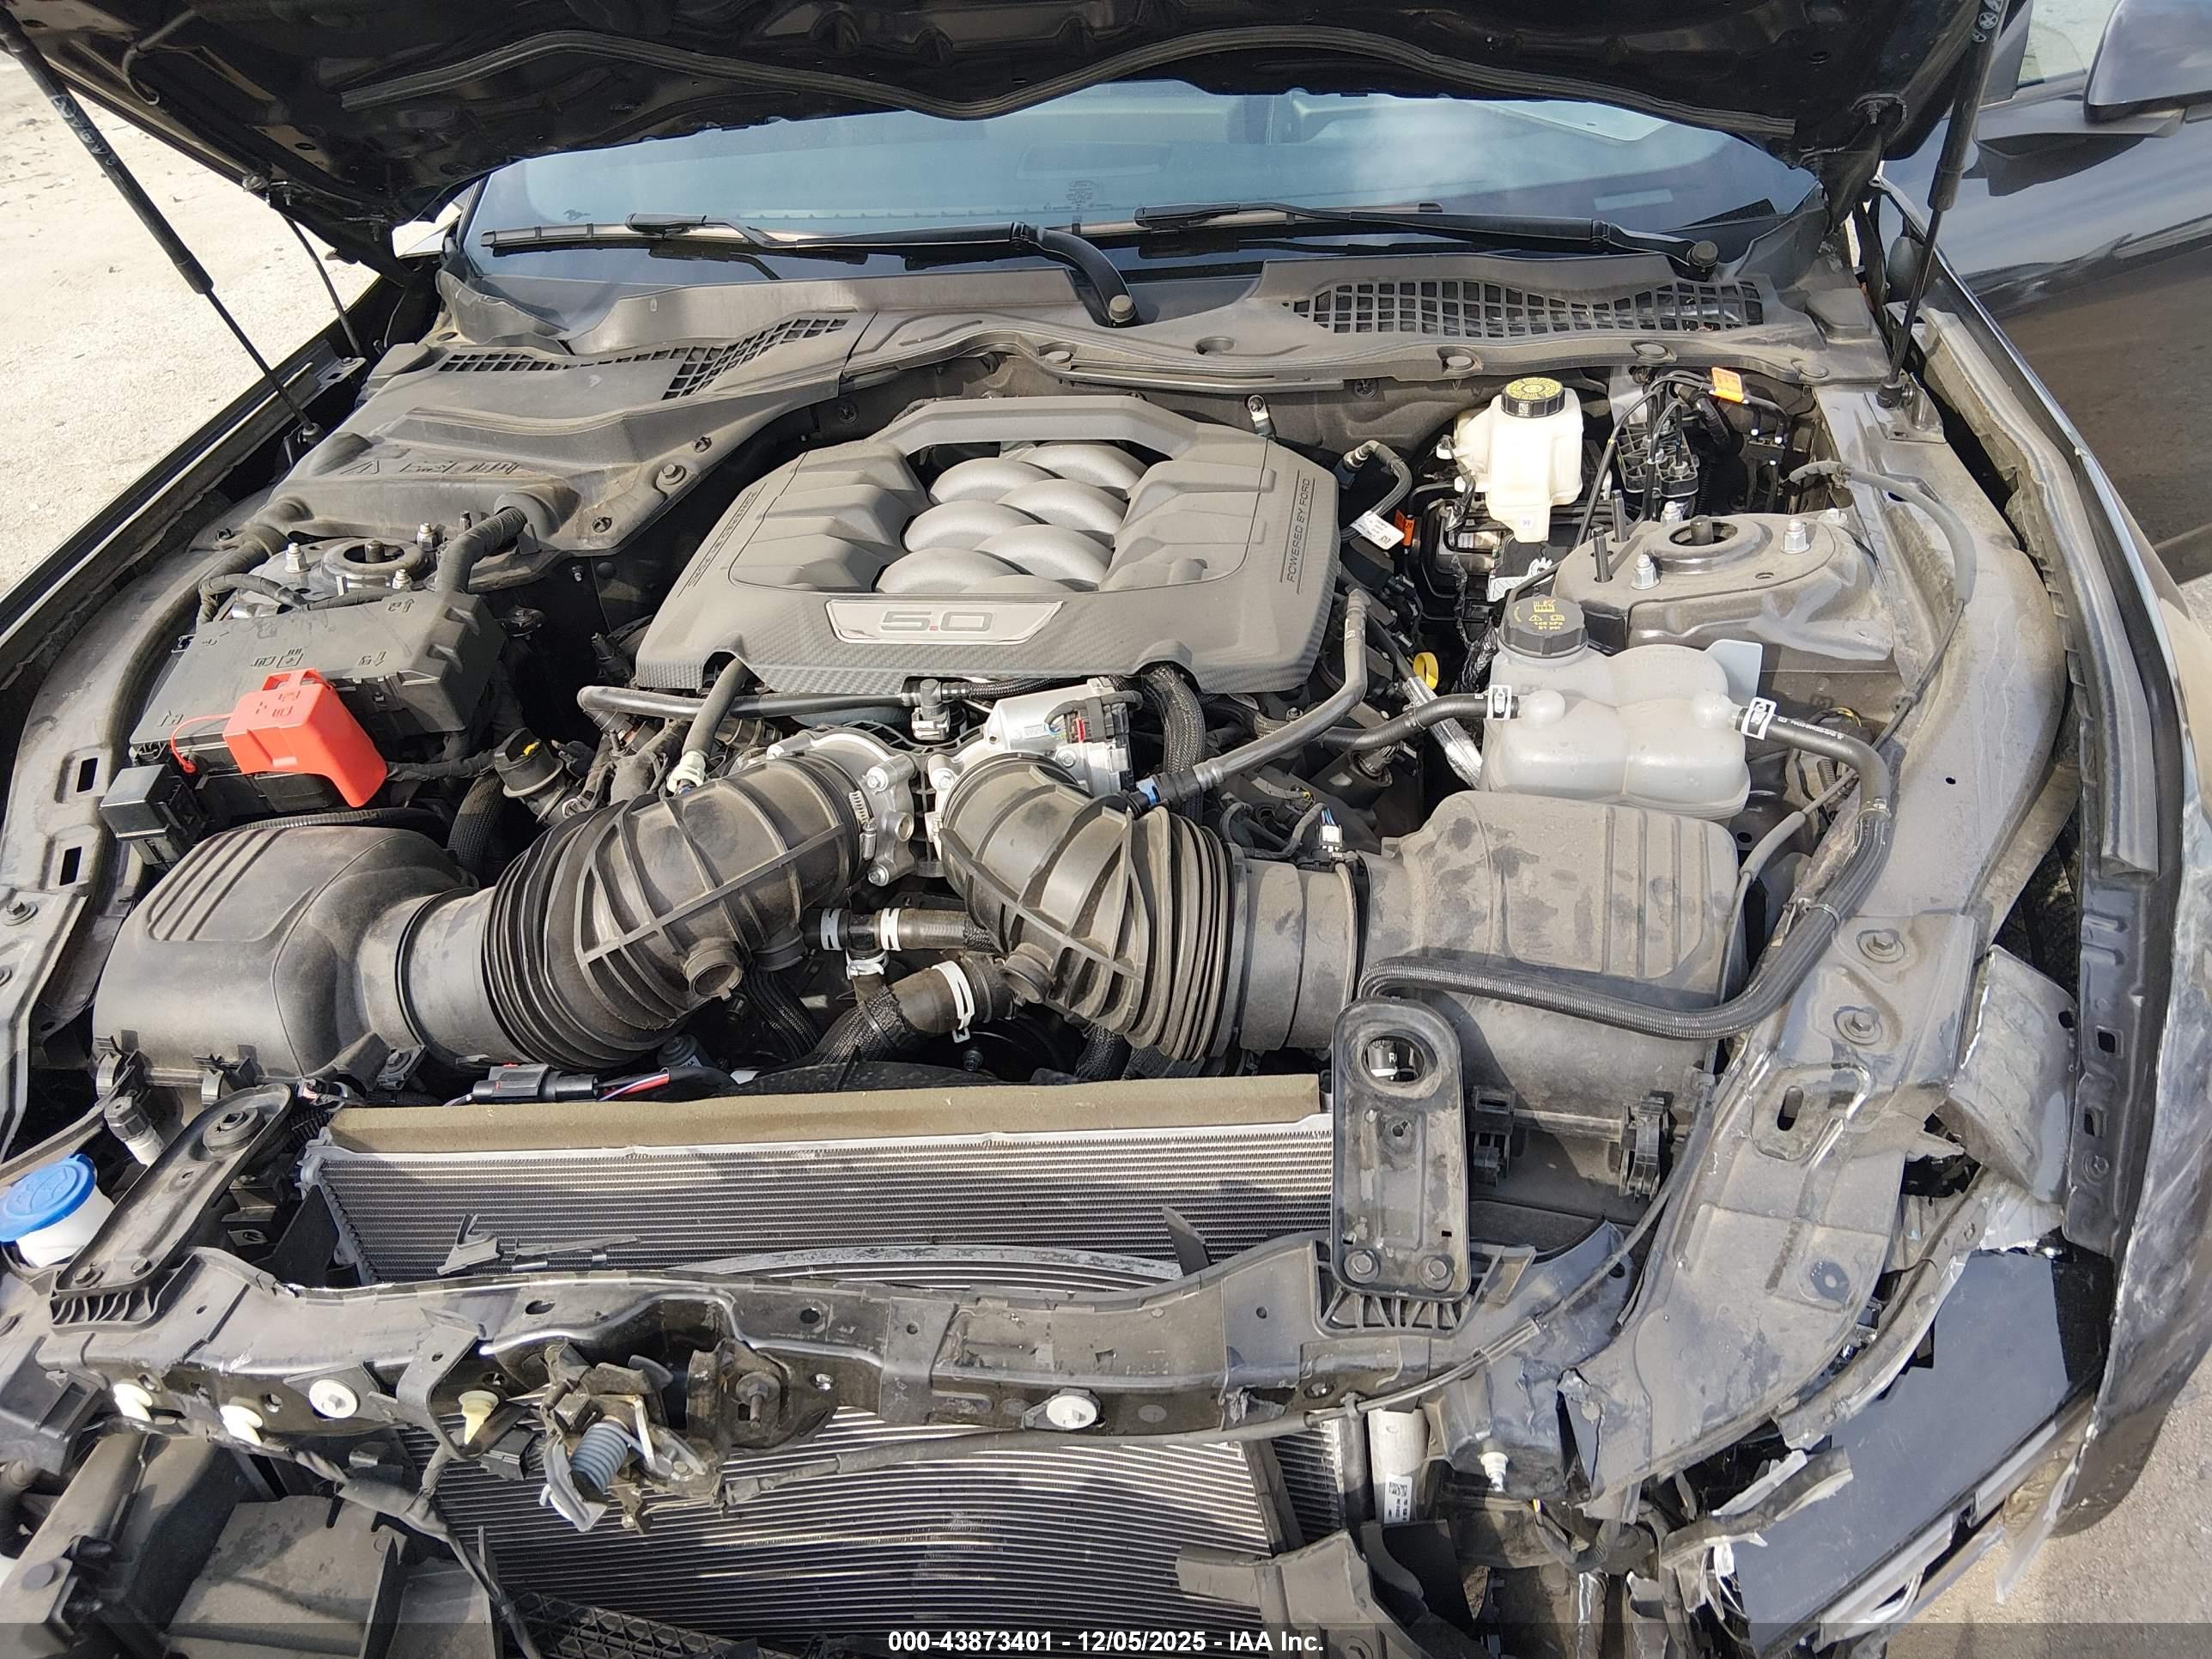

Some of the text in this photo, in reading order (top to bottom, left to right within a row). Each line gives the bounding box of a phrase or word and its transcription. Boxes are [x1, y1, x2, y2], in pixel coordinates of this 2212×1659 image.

[1286, 477, 1311, 583] POWERED BY FORD
[880, 611, 994, 632] 5.0
